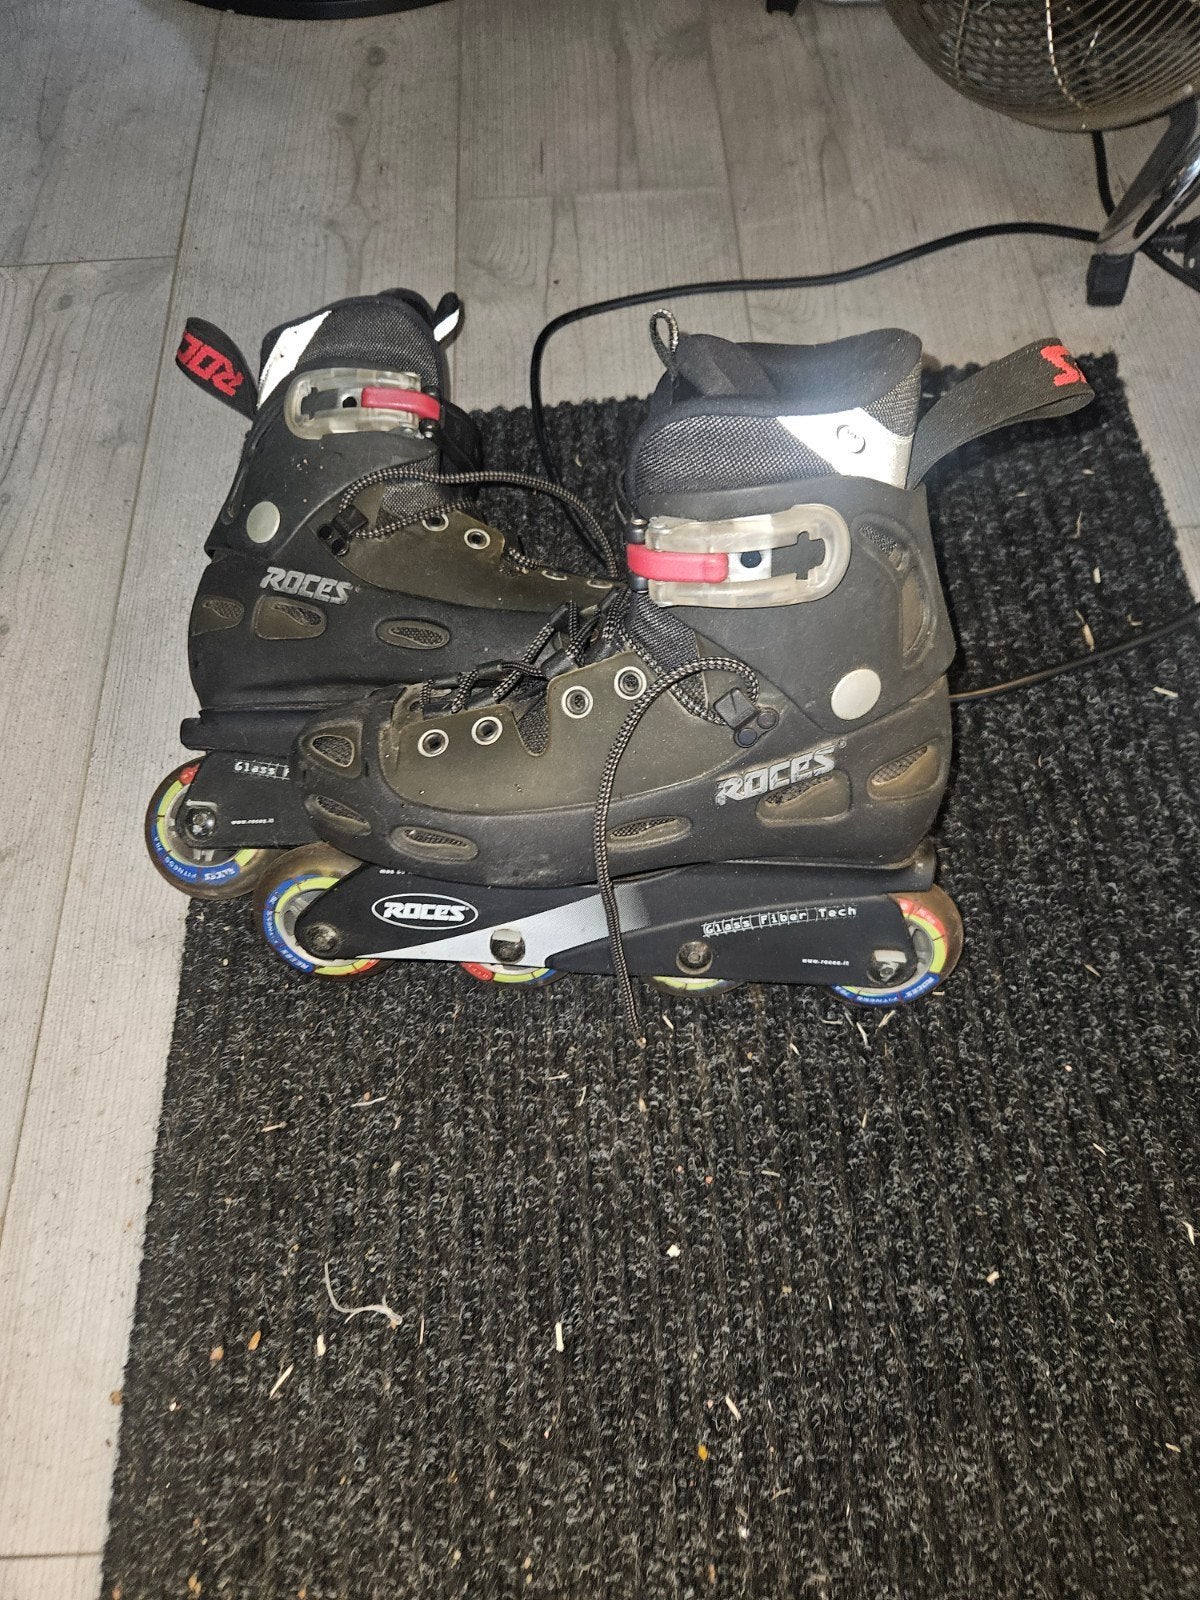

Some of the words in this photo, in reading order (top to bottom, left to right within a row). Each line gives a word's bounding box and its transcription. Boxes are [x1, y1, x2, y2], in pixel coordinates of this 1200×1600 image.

[176, 331, 241, 397] ROC
[260, 566, 353, 605] ROCES
[234, 761, 276, 776] Glass
[715, 746, 835, 805] ROCES
[383, 902, 468, 922] ROCES
[704, 919, 751, 936] Glass
[760, 911, 807, 925] Fiber
[818, 906, 857, 918] Tech
